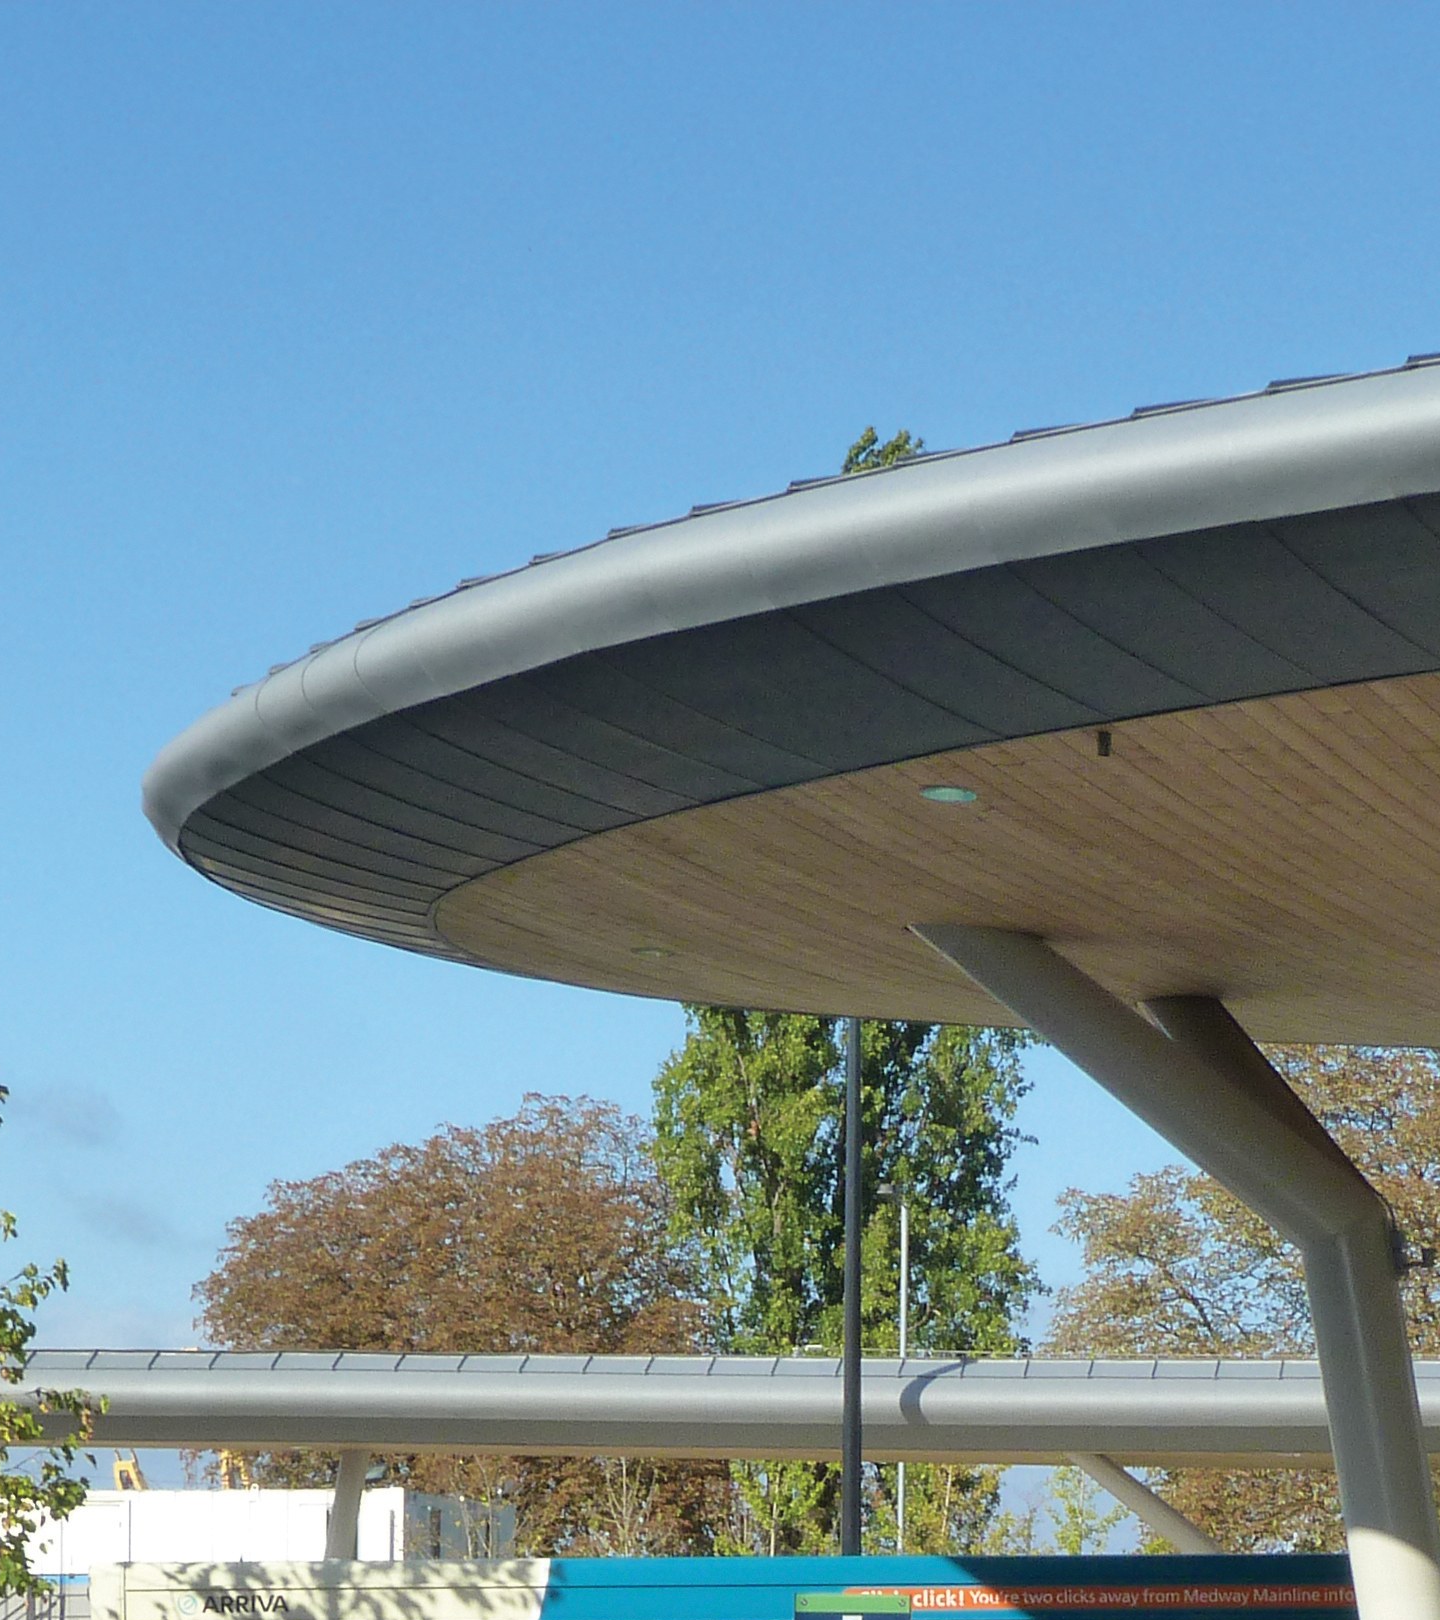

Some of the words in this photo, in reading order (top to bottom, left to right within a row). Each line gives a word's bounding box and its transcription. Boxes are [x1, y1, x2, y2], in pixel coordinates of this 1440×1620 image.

[202, 1594, 289, 1613] ARRIVA
[912, 1589, 965, 1608] click!
[968, 1589, 1020, 1605] You're
[1022, 1590, 1053, 1605] two
[1056, 1588, 1096, 1604] clicks
[1098, 1590, 1138, 1607] away
[1142, 1588, 1181, 1604] from
[1183, 1588, 1251, 1607] Medway
[1253, 1587, 1321, 1603] Mainline
